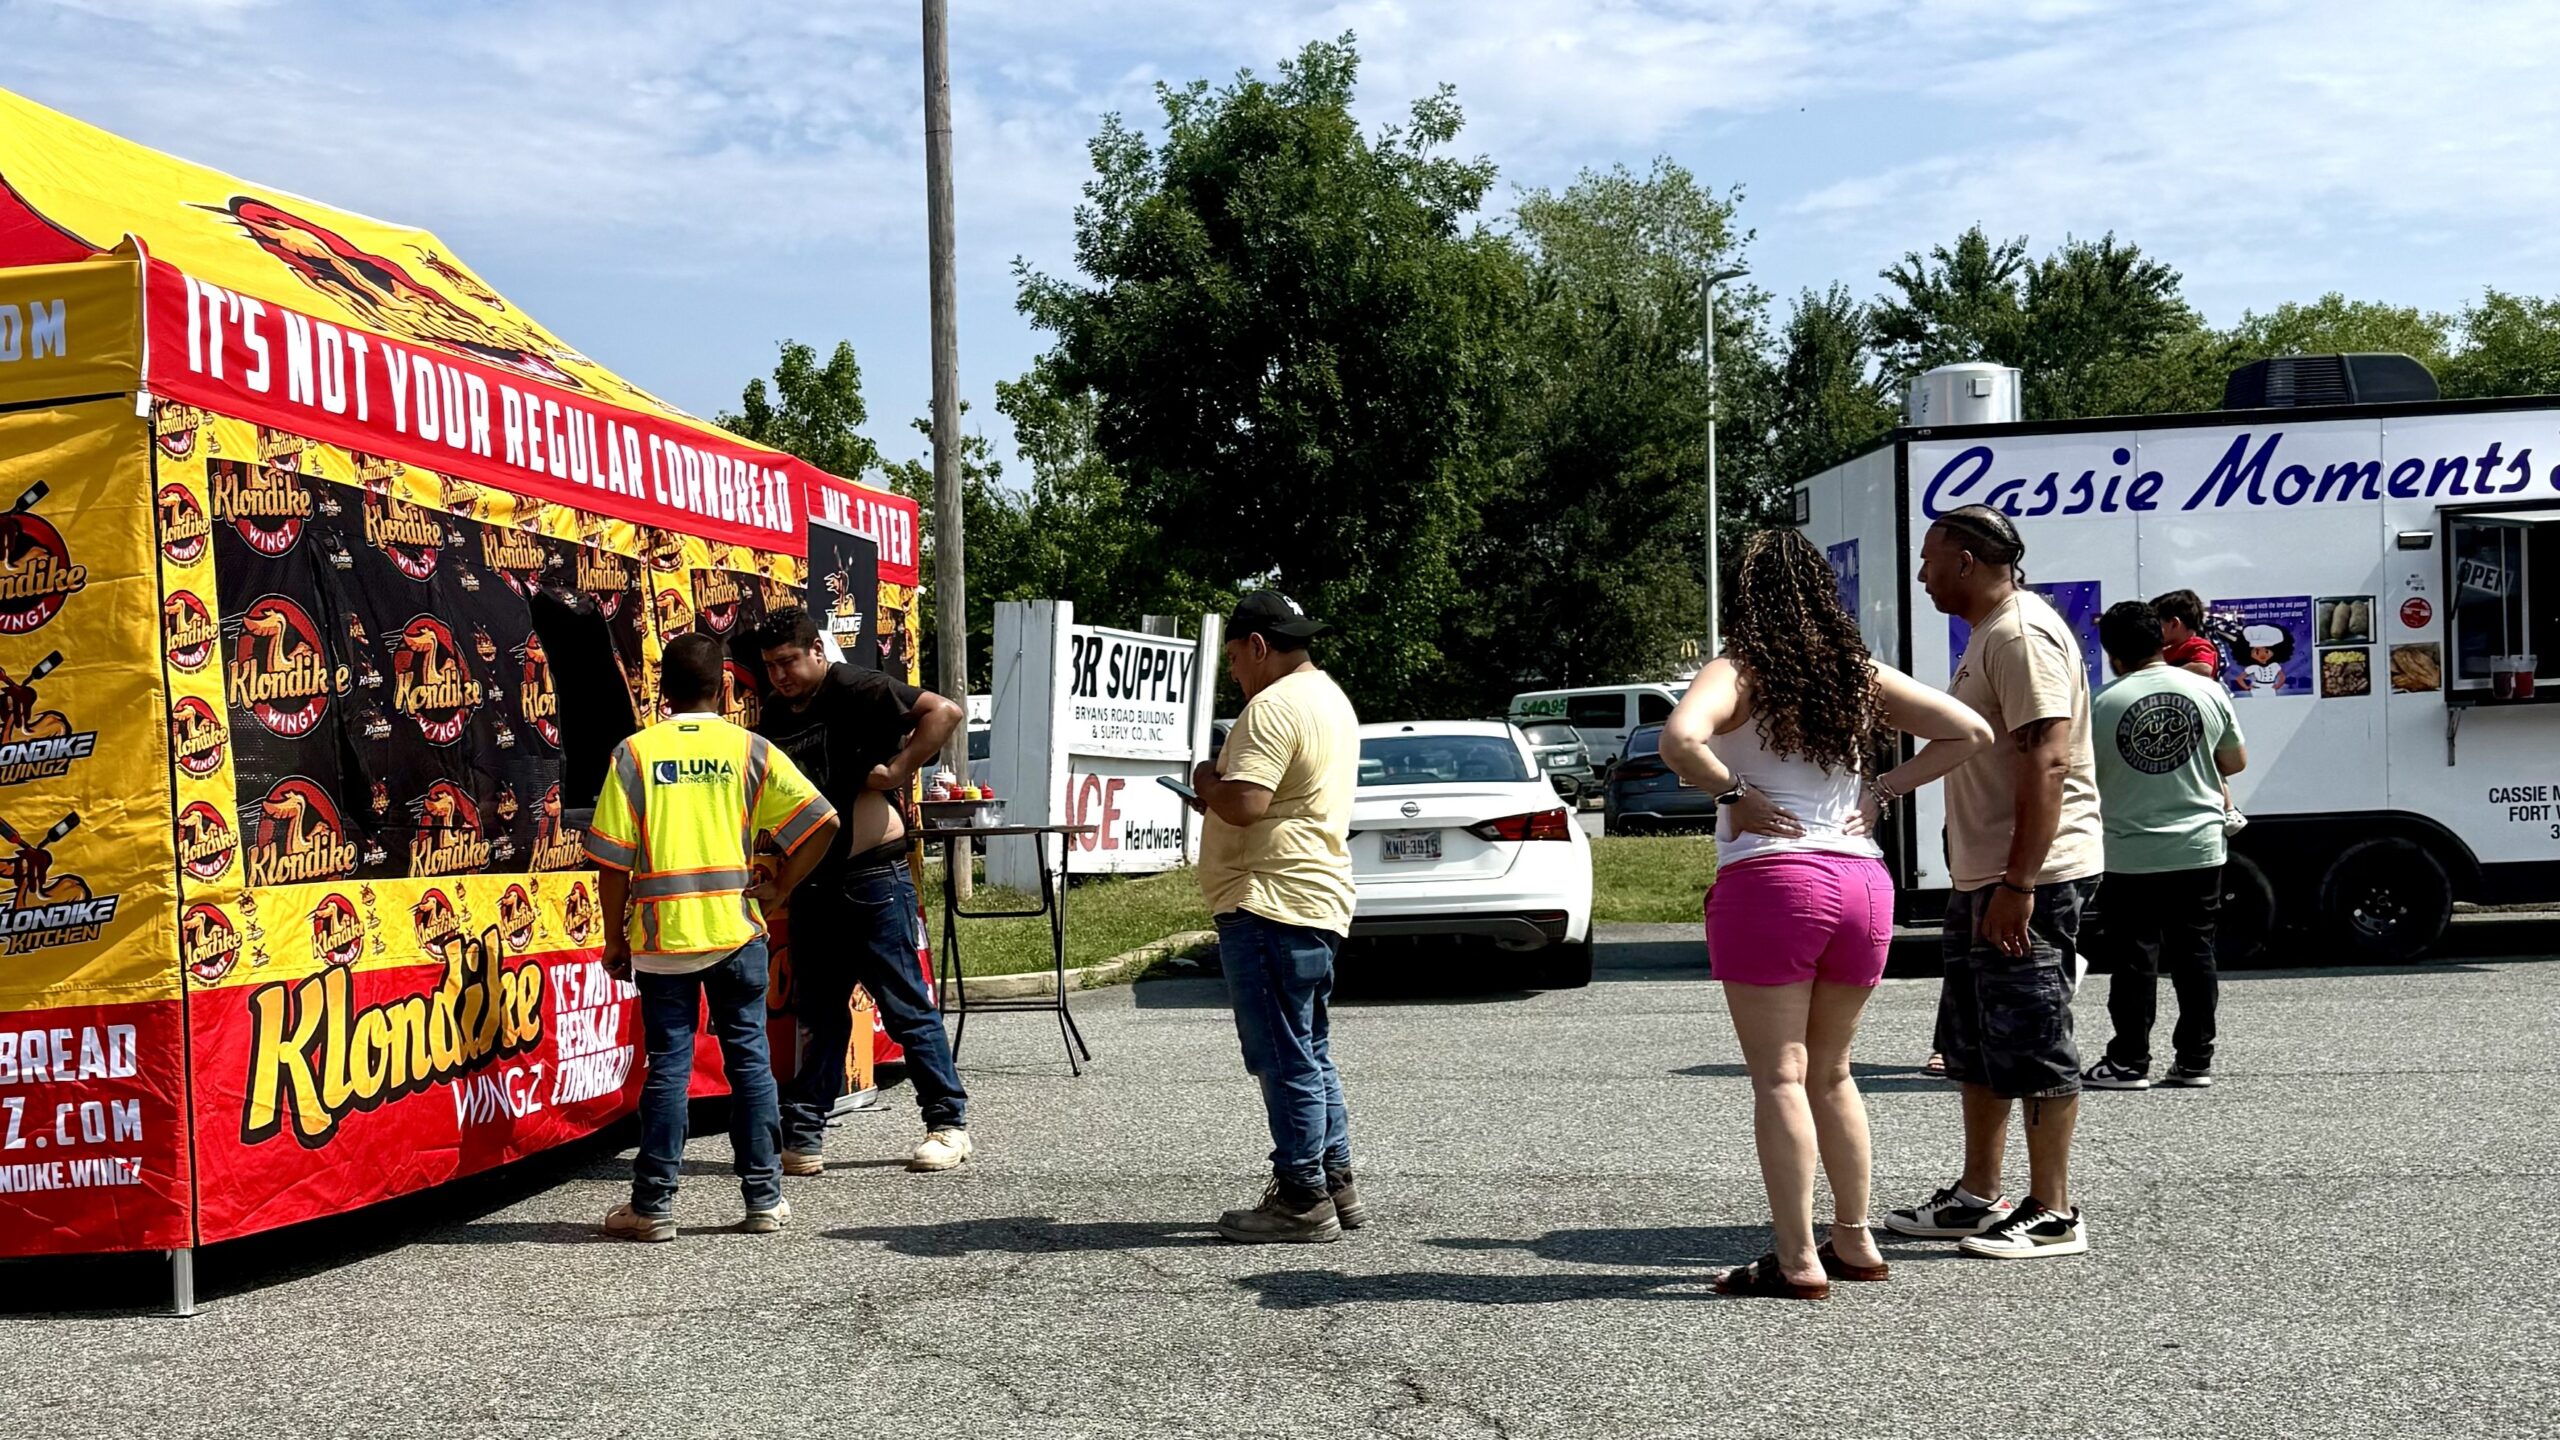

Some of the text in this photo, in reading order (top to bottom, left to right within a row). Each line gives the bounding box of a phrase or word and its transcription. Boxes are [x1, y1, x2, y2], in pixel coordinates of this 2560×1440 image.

[183, 272, 793, 534] IT'S NOT YOUR REGULAR CORNBREAD
[1922, 432, 2532, 520] Cassie Moments
[214, 473, 312, 523] Klondike
[161, 512, 210, 547] londike
[250, 525, 295, 551] WINGZ
[365, 504, 443, 549] Klondike
[821, 485, 912, 567] WE CATER
[171, 539, 201, 559] WINGZ
[481, 531, 546, 574] Klondike
[577, 555, 629, 592] Klondike
[2459, 559, 2514, 595] OPEN
[165, 618, 219, 656] londike
[230, 652, 349, 709] Klondike
[1107, 643, 1194, 704] SUPPLY
[268, 702, 317, 733] WINGZ
[1075, 706, 1175, 725] BRYANS ROAD BUILDING
[1092, 725, 1098, 739] &
[1100, 726, 1128, 740] SUPPLY
[176, 721, 229, 759] londike
[1, 758, 67, 784] WINGZ
[188, 750, 220, 771] WINGZ
[679, 759, 733, 776] LUNA
[2488, 786, 2547, 804] CASSIE
[2509, 804, 2551, 822] FORT
[409, 830, 490, 878] Klondike
[1125, 820, 1183, 851] Hardware
[249, 831, 356, 888] Klondike
[10, 924, 99, 953] KITCHEN
[185, 928, 242, 968] londike
[550, 963, 582, 1014] IT'S
[244, 926, 542, 1142] Klondike
[556, 1003, 620, 1060] REGULAR
[0, 1024, 137, 1085] BREAD
[551, 1045, 634, 1106] CORNBREAD
[452, 1064, 543, 1132] WINGZ
